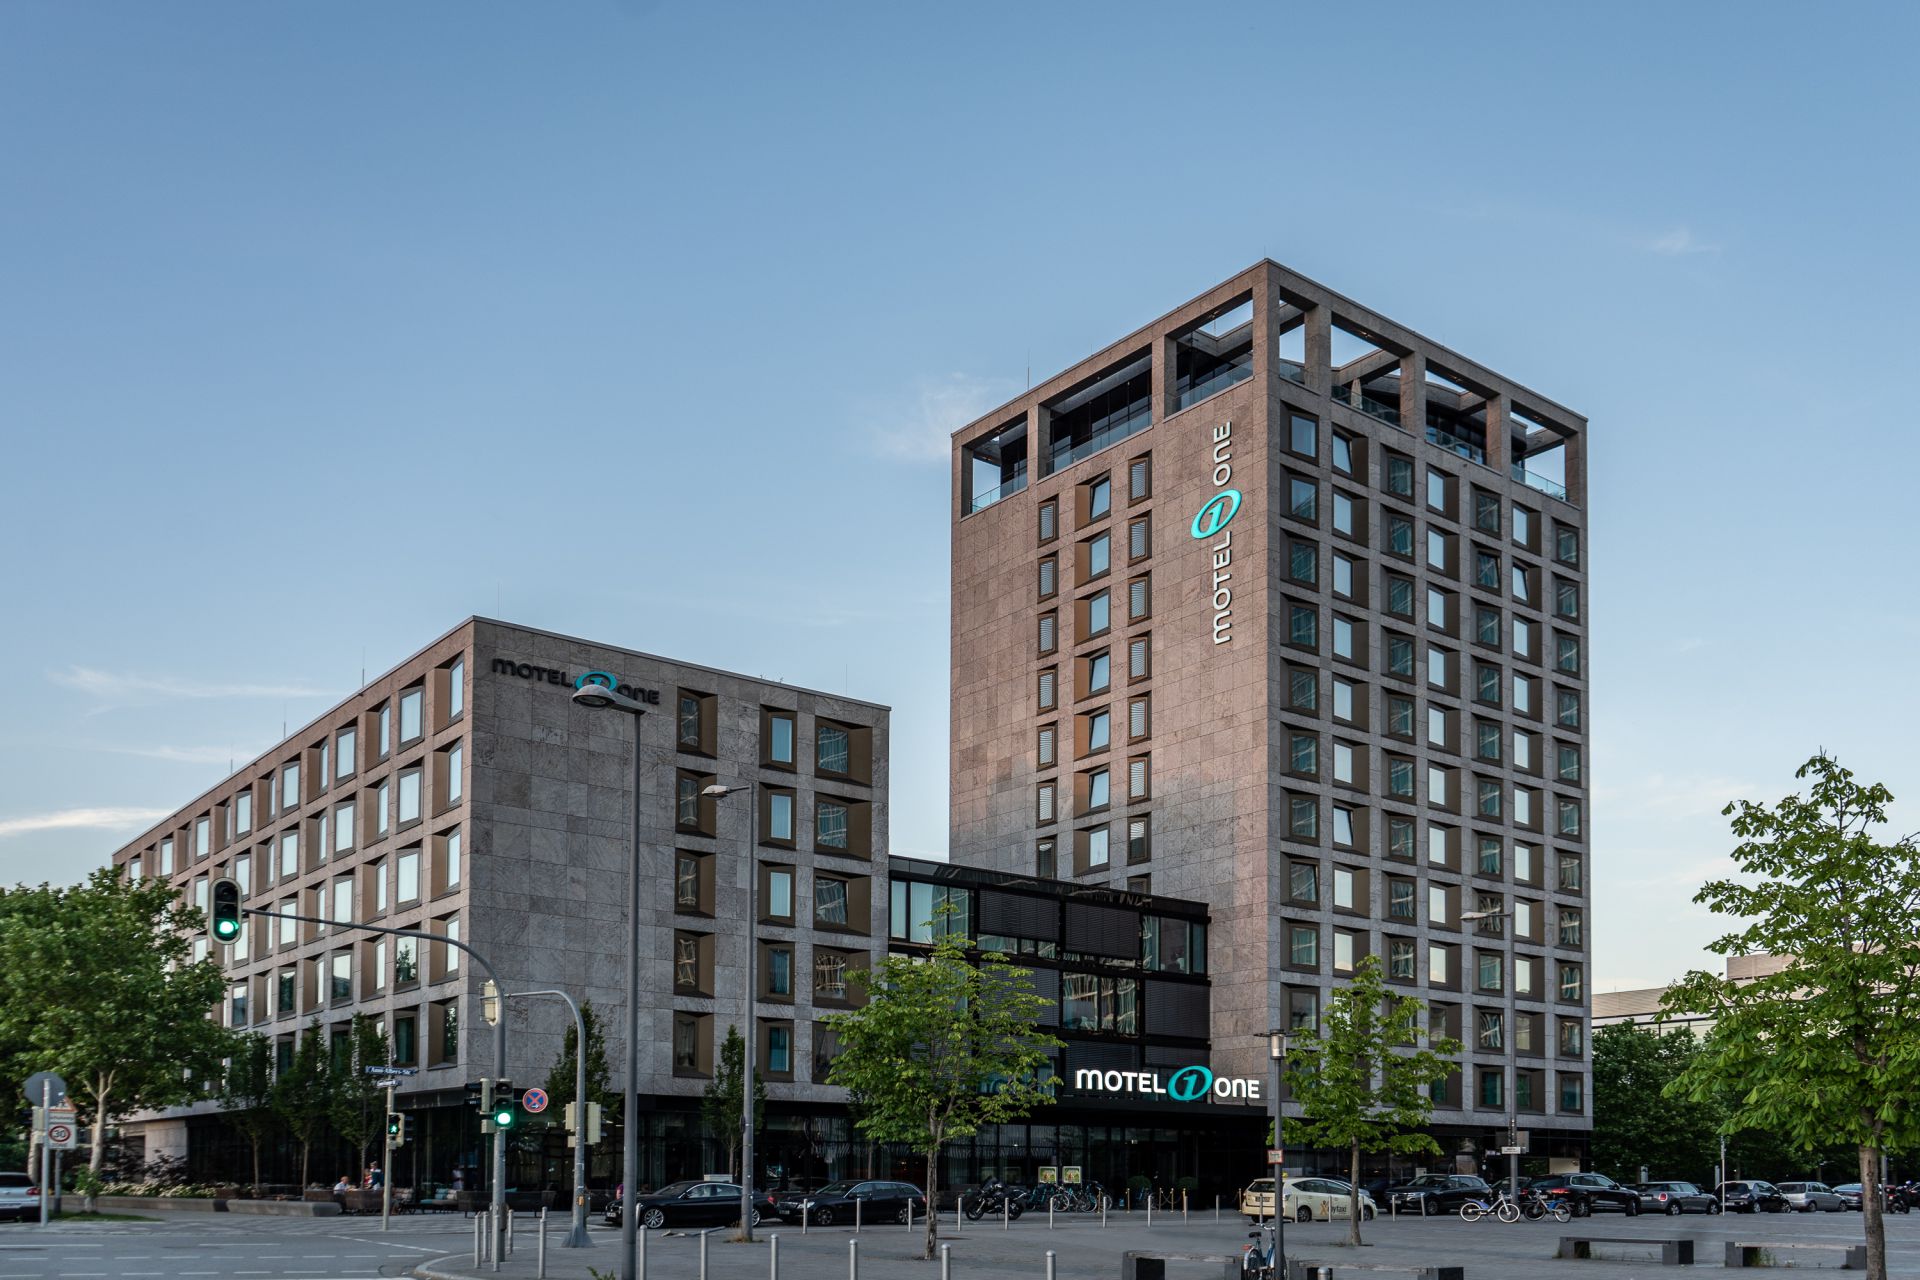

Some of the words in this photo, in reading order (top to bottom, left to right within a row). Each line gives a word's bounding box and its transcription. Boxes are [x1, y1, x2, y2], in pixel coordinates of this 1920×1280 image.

[1213, 421, 1232, 487] ONE
[1213, 531, 1232, 645] MOTEL
[492, 658, 574, 688] MOTEL
[617, 683, 661, 705] ONE
[1075, 1069, 1167, 1094] MOTEL
[1215, 1077, 1260, 1098] ONE
